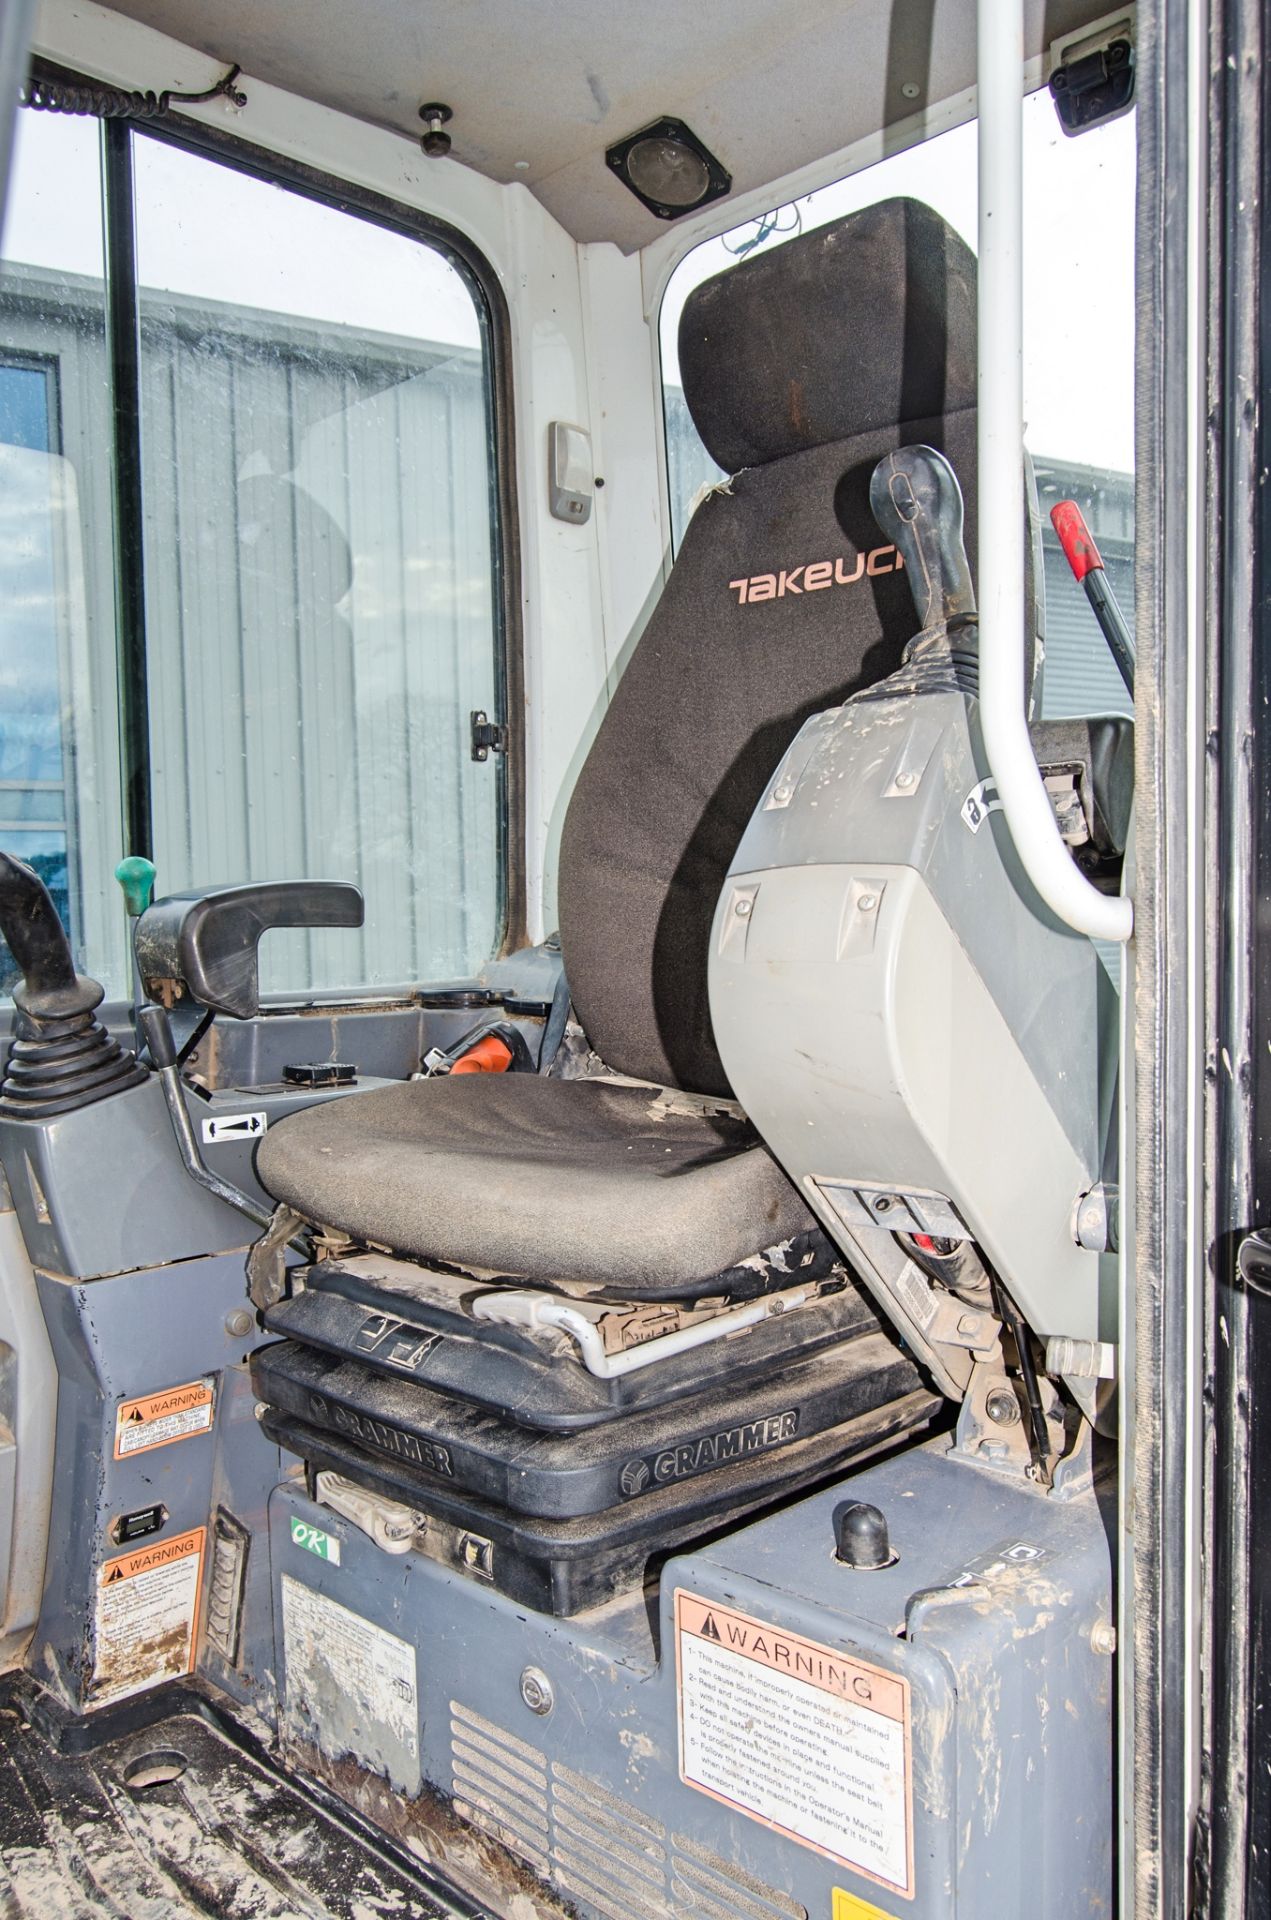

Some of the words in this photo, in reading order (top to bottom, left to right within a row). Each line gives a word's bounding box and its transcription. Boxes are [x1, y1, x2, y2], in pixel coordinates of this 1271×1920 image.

[150, 1389, 206, 1414] WARNING
[335, 1405, 453, 1476] GRAMMER
[654, 1410, 797, 1482] GRAMMER
[129, 1539, 194, 1571] WARNING
[292, 1524, 325, 1554] OK
[698, 1666, 711, 1677] can
[713, 1673, 733, 1687] cause
[782, 1703, 789, 1712] or
[793, 1708, 810, 1721] even
[698, 1650, 712, 1663] This
[796, 1694, 830, 1716] operated
[833, 1711, 842, 1720] or
[844, 1715, 889, 1741] maintained
[726, 1622, 873, 1702] WARNING
[699, 1677, 716, 1691] Read
[718, 1686, 731, 1698] and
[734, 1693, 775, 1719] understand
[778, 1713, 790, 1725] the
[792, 1720, 820, 1739] owners
[823, 1734, 852, 1754] manual
[855, 1748, 889, 1771] supplied
[699, 1703, 716, 1718] Keep
[753, 1728, 780, 1747] devices
[783, 1742, 789, 1751] in
[815, 1758, 830, 1771] and
[700, 1691, 714, 1704] with
[717, 1699, 729, 1711] this
[731, 1706, 761, 1725] machine
[763, 1719, 787, 1737] before
[700, 1730, 706, 1738] is
[738, 1748, 770, 1770] fastened
[773, 1765, 799, 1784] around
[700, 1741, 723, 1759] Follow
[725, 1754, 736, 1766] the
[784, 1783, 790, 1792] in
[793, 1787, 805, 1800] the
[808, 1794, 849, 1822] Operator's
[853, 1816, 882, 1838] Manual
[702, 1768, 733, 1792] transport
[712, 1723, 724, 1734] not
[726, 1729, 753, 1749] operate
[755, 1741, 768, 1756] the
[770, 1750, 801, 1772] machine
[804, 1767, 828, 1785] unless
[831, 1779, 844, 1792] the
[847, 1787, 864, 1801] seat
[867, 1795, 882, 1811] belt
[701, 1755, 719, 1770] when
[752, 1780, 764, 1792] the
[766, 1788, 797, 1809] machine
[799, 1805, 807, 1814] or
[811, 1809, 847, 1835] fastening
[850, 1828, 855, 1838] it
[858, 1833, 866, 1843] to
[870, 1838, 883, 1852] the
